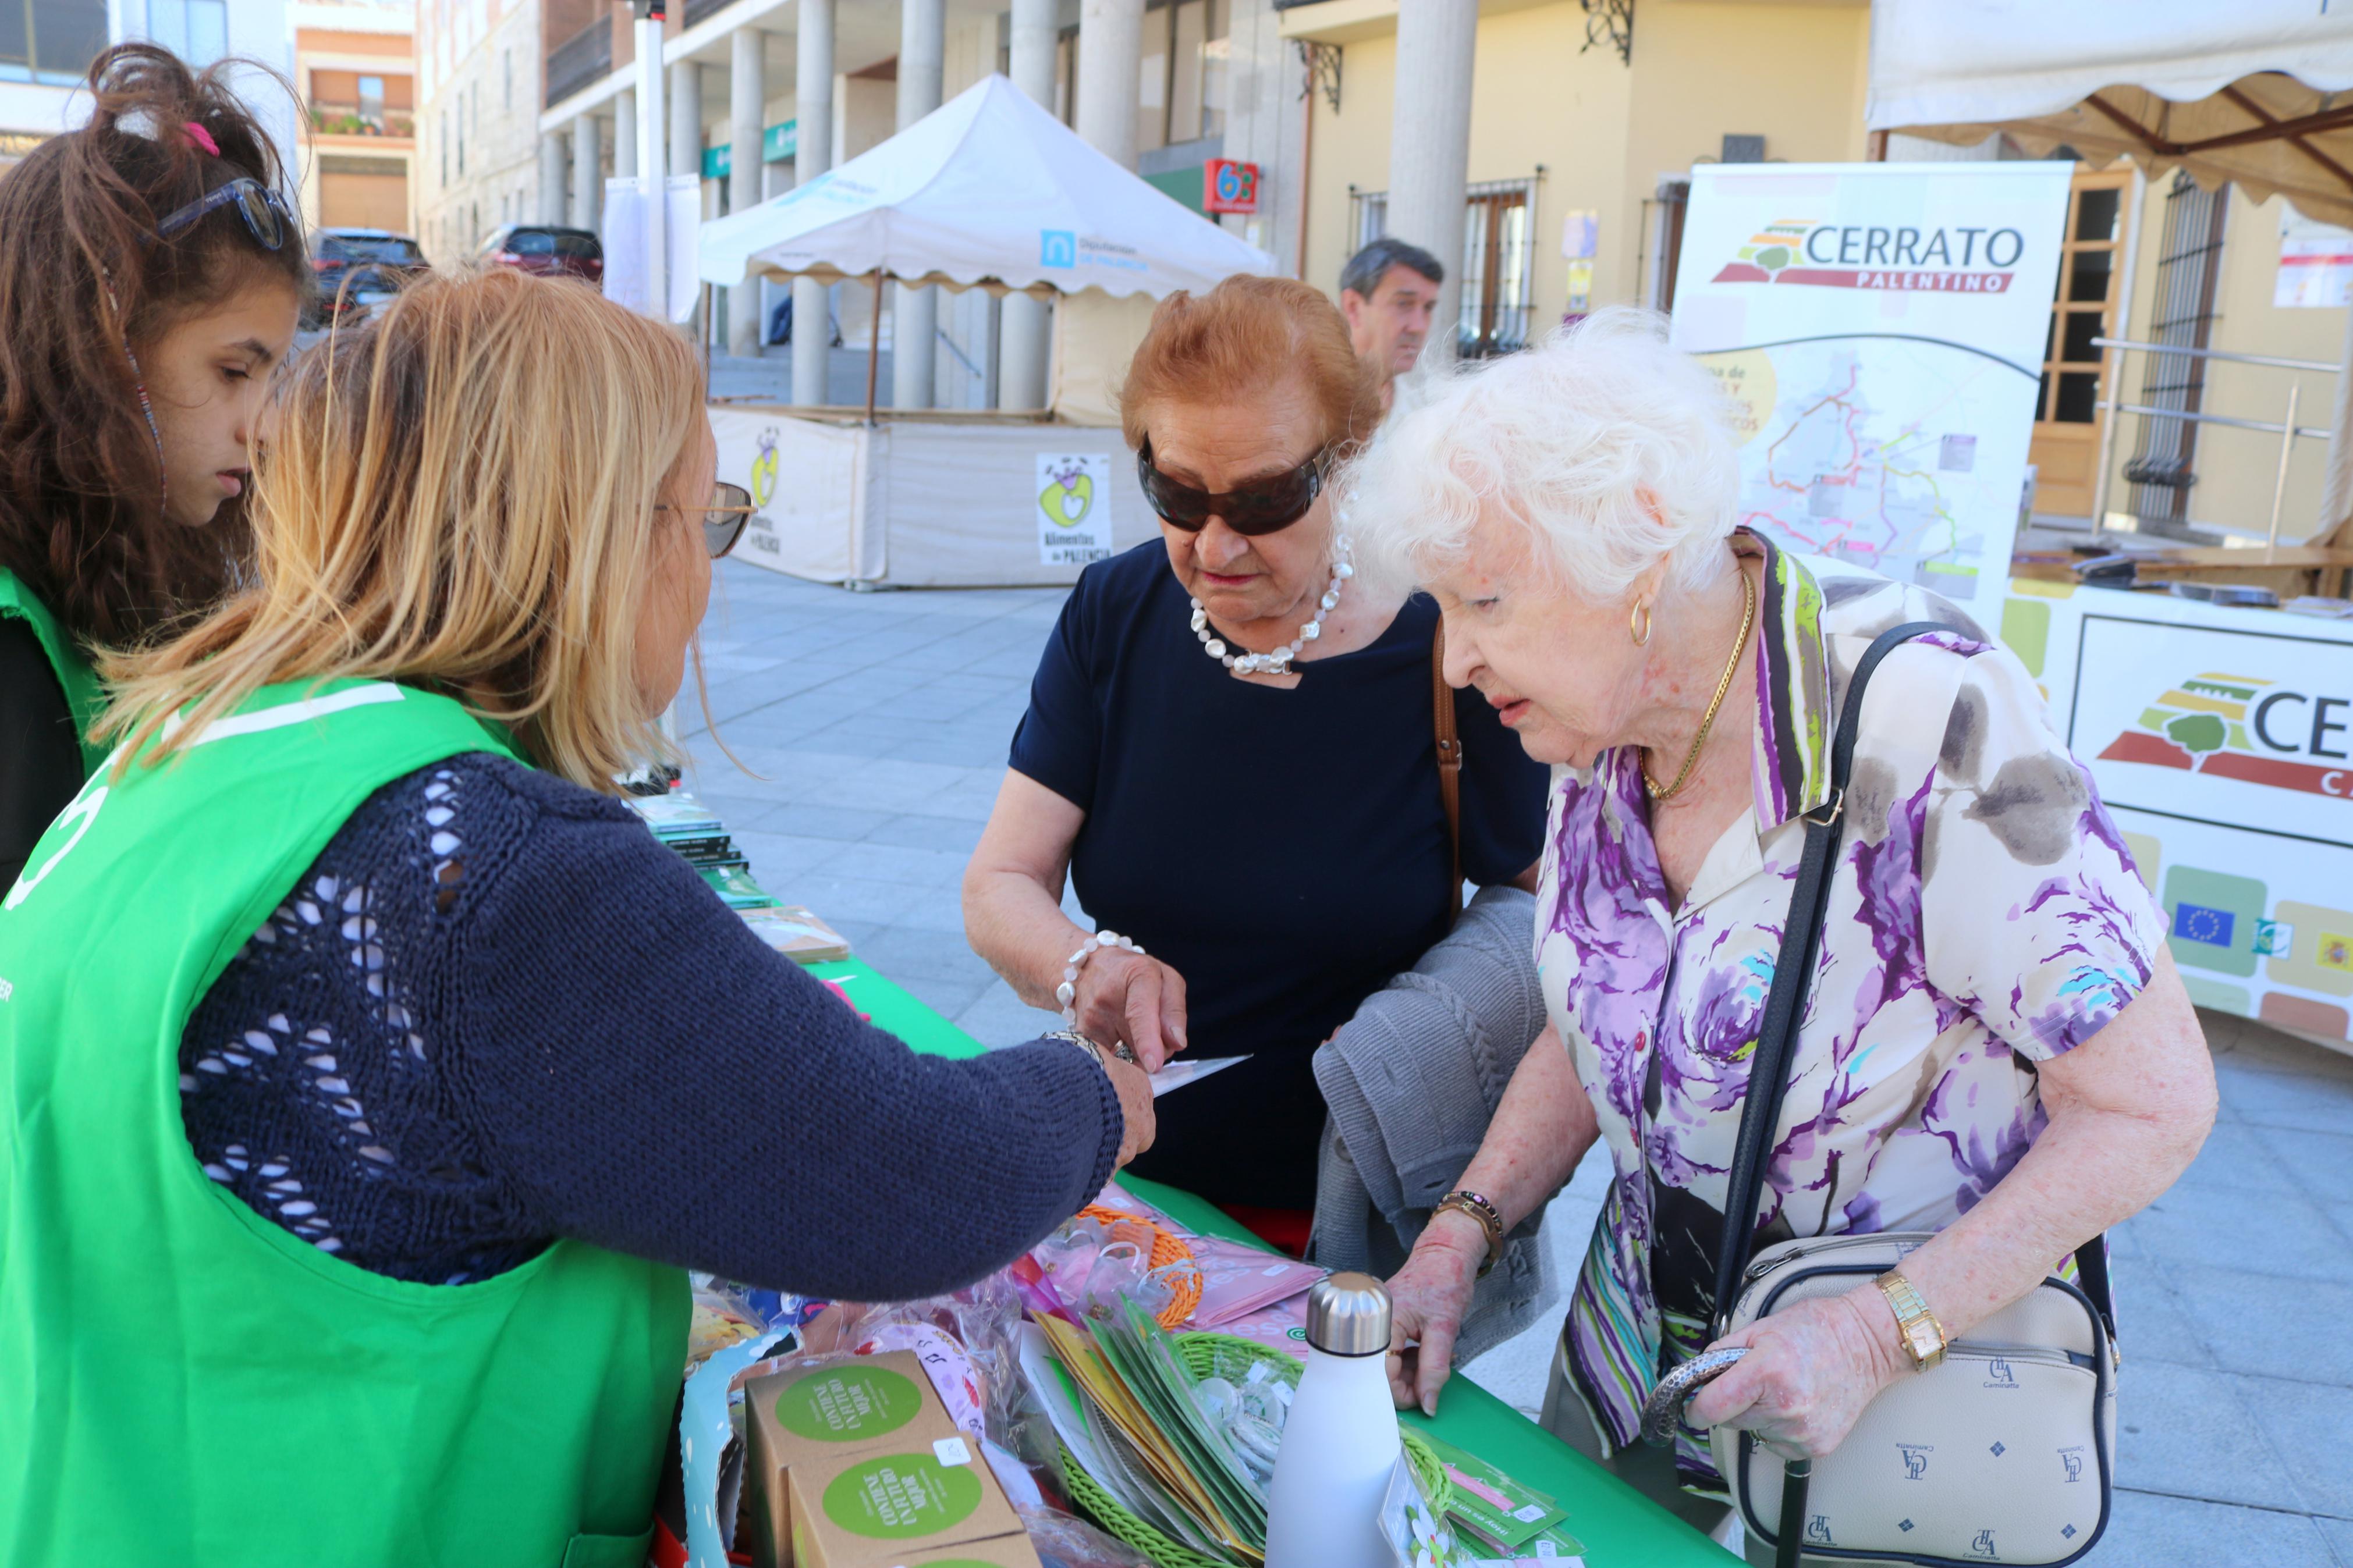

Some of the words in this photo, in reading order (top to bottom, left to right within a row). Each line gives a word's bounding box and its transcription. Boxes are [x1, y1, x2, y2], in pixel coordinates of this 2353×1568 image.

[1807, 226, 2024, 268] CERRATO
[1857, 272, 2003, 292] PALENTINO
[1045, 532, 1094, 545] Alimentos
[1896, 1442, 1935, 1452] Caminatta
[1457, 1504, 1472, 1513] un
[1962, 1552, 2001, 1560] Caminatta
